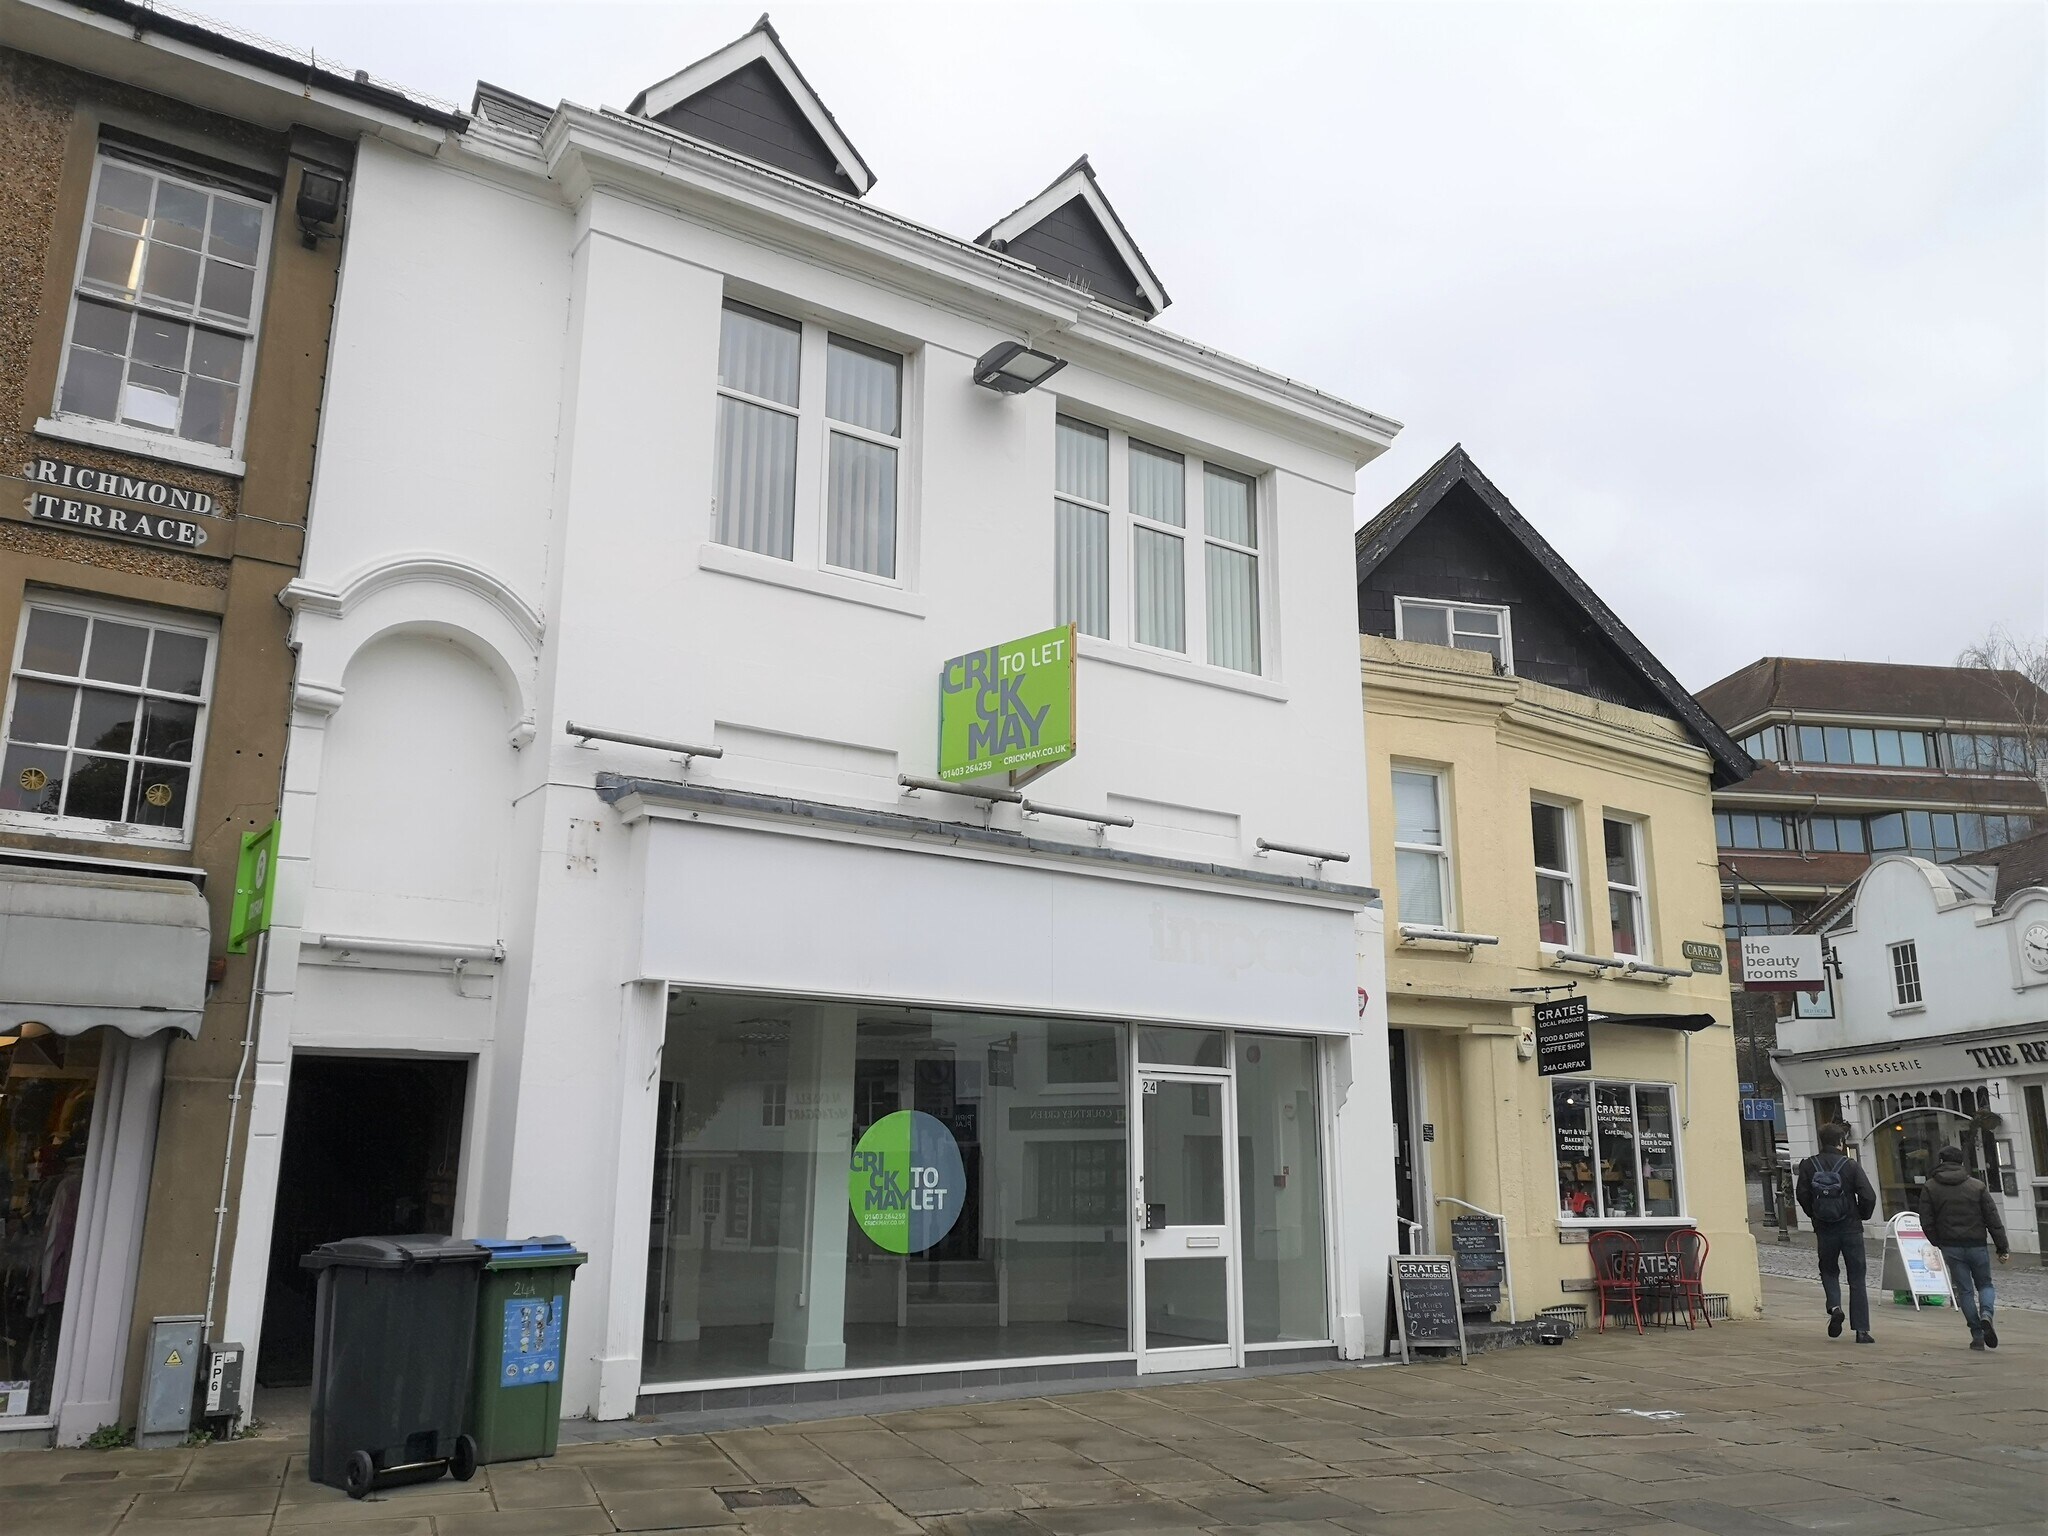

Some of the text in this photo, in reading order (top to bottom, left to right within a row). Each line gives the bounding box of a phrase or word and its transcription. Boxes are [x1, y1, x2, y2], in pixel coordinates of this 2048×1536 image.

[37, 460, 212, 514] RICHMOND
[38, 494, 196, 544] TERRACE
[1000, 640, 1065, 675] TO LET
[968, 704, 1051, 761] MAY
[1003, 744, 1067, 765] CRICKMAY.CO.UK
[942, 761, 992, 779] 01403 264259
[1687, 944, 1719, 958] CARFAX
[1745, 943, 1770, 954] the
[1746, 956, 1800, 968] beauty
[1747, 969, 1798, 979] rooms
[1537, 1004, 1585, 1021] CRATES
[1558, 1016, 1583, 1025] PRODUCE
[1540, 1034, 1558, 1043] FOOD
[1564, 1031, 1585, 1039] DRINK
[1541, 1045, 1566, 1054] COFFEE
[1567, 1042, 1585, 1051] SHOP
[1965, 1040, 2048, 1068] THE RE
[1543, 1060, 1586, 1072] 24A CARFAX
[1825, 1059, 1922, 1078] PUB BRASSERIE
[1143, 1081, 1156, 1093] 24
[1596, 1105, 1631, 1115] CRATES
[910, 1167, 939, 1188] TO
[865, 1190, 911, 1211] MAY
[911, 1189, 947, 1210] LET
[1400, 1264, 1448, 1273] CRATES
